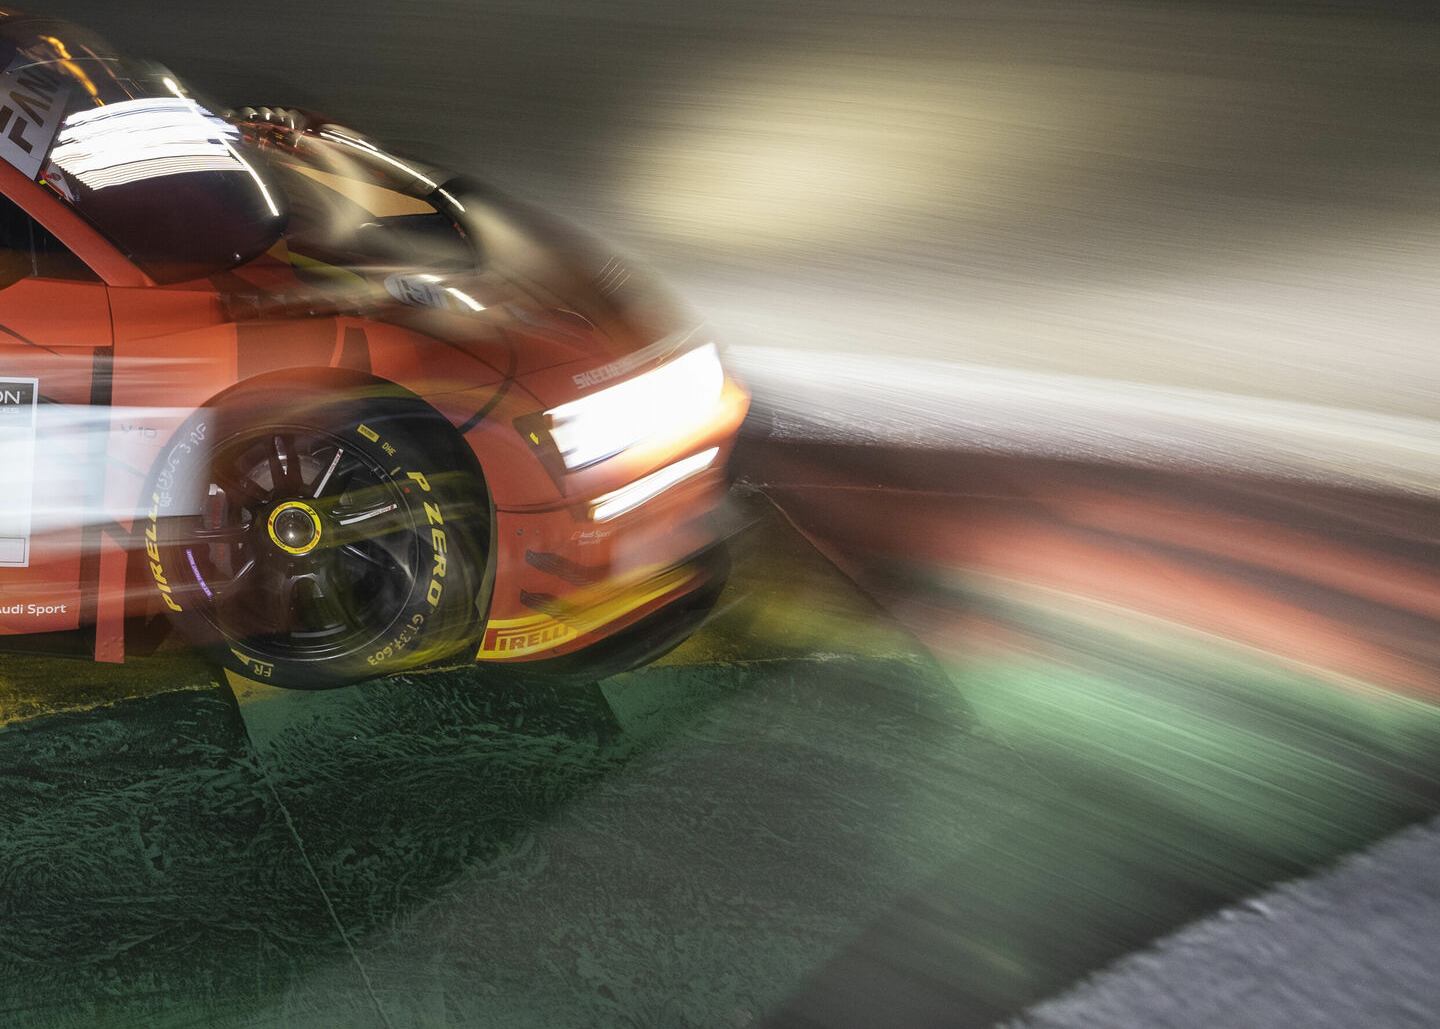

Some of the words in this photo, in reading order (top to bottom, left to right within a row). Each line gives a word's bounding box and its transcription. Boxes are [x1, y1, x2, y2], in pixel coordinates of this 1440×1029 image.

[381, 442, 396, 457] DHE
[145, 492, 182, 612] PIRELLI
[26, 603, 67, 617] Sport
[367, 613, 425, 666] GT.37.603
[483, 618, 569, 652] PIRELLI
[254, 664, 272, 678] FR
